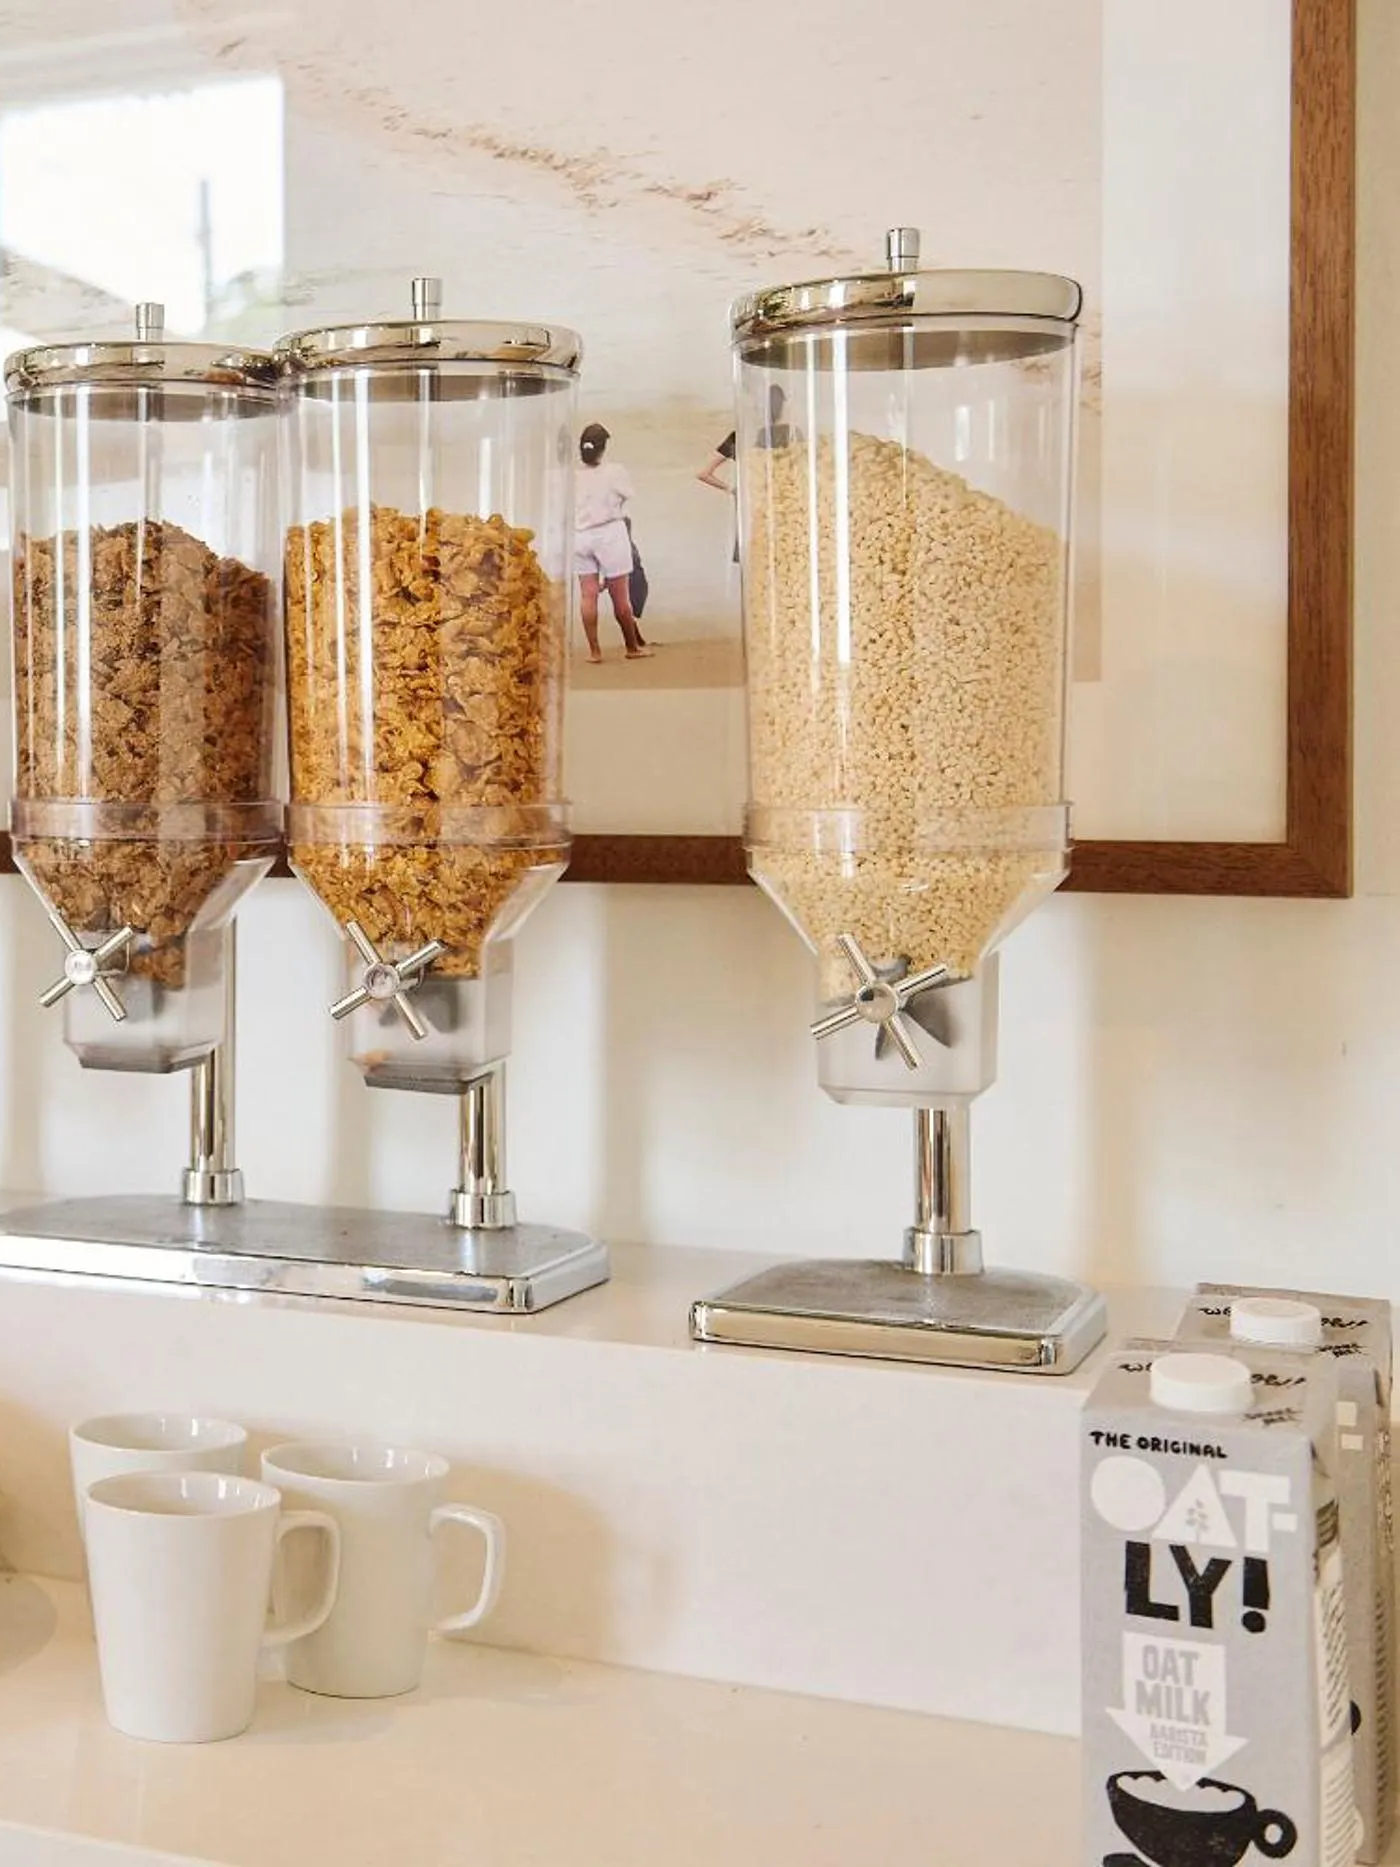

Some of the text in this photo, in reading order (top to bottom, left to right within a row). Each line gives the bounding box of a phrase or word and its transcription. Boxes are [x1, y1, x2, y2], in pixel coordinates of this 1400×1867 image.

[1089, 1430, 1228, 1459] THE ORIGINAL
[1124, 1540, 1270, 1633] LY!
[1142, 1644, 1200, 1687] OAT
[1135, 1680, 1211, 1726] MILK
